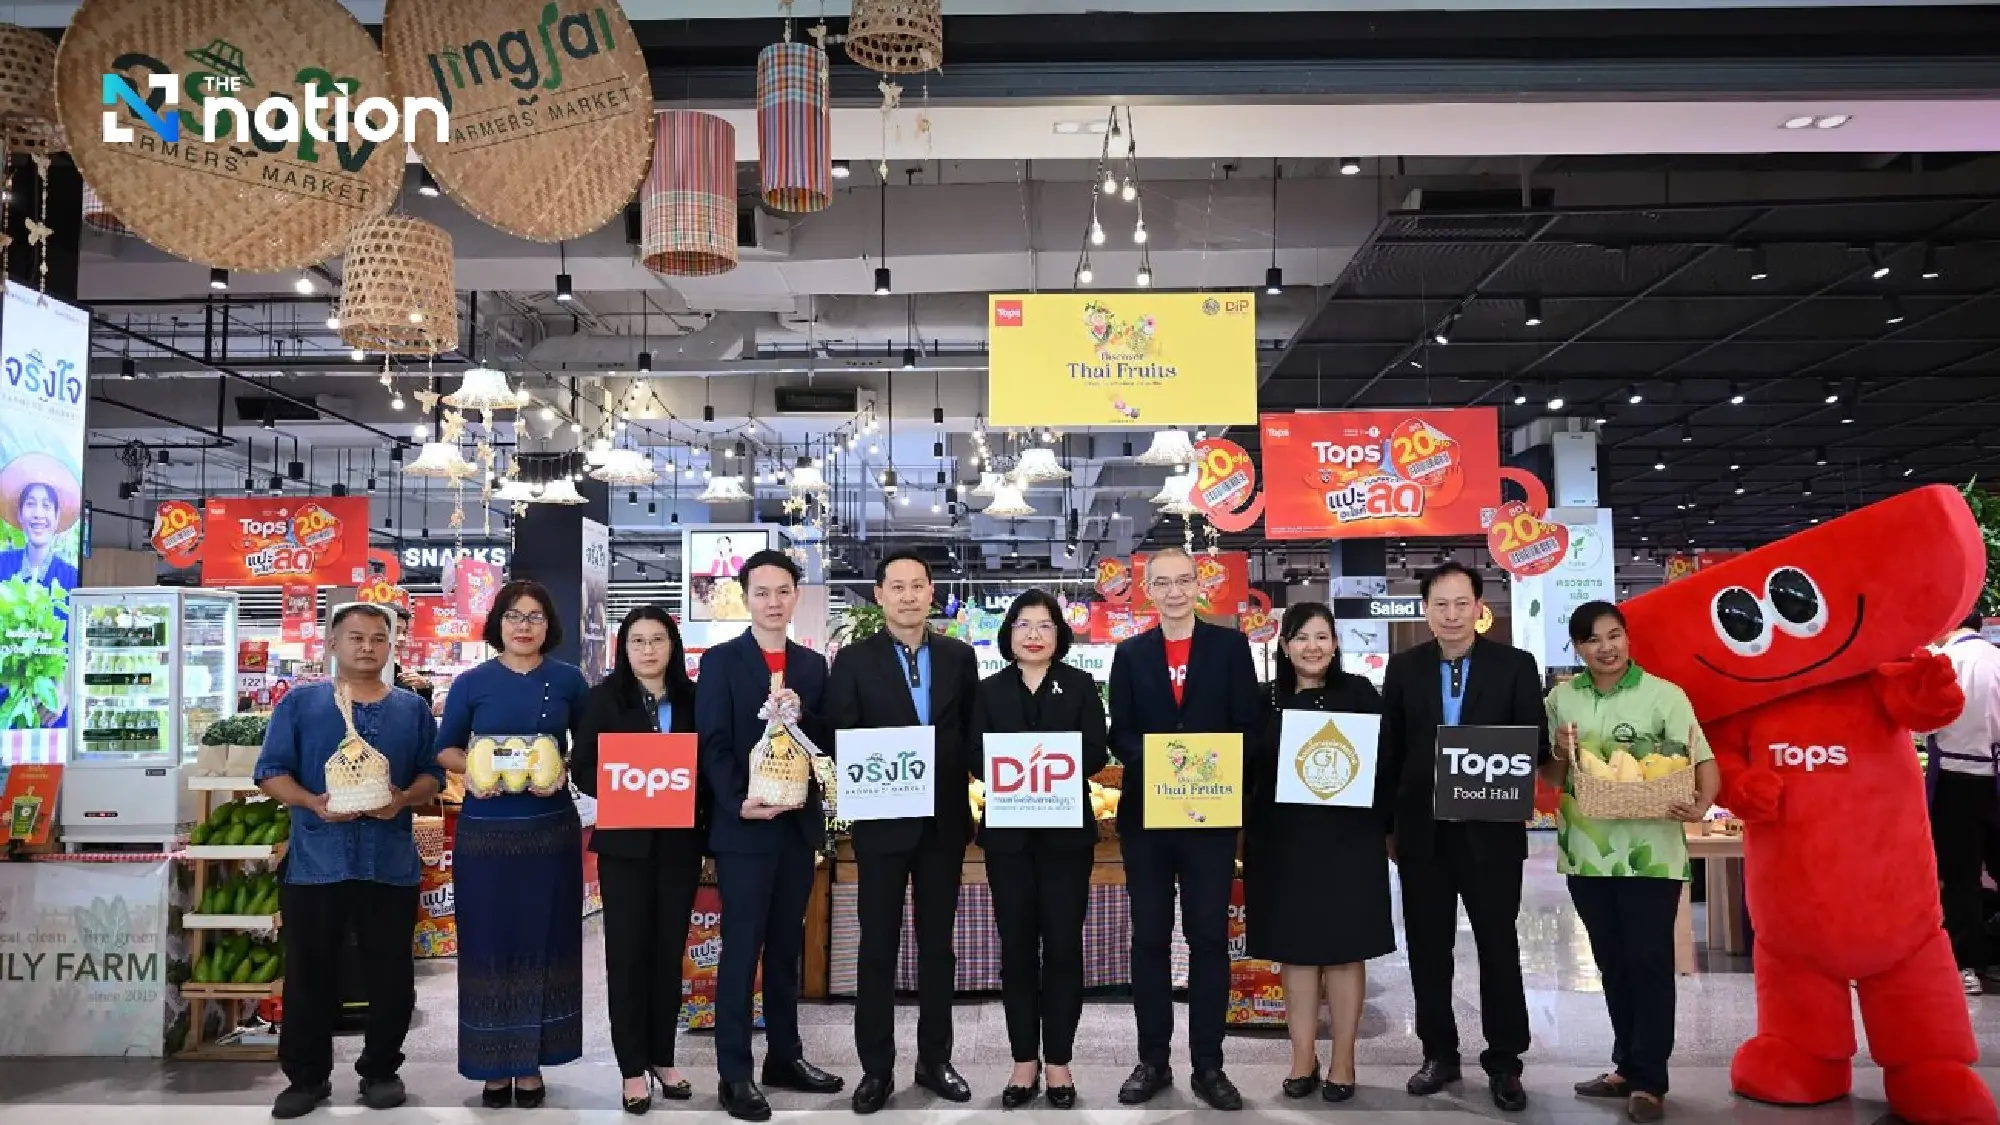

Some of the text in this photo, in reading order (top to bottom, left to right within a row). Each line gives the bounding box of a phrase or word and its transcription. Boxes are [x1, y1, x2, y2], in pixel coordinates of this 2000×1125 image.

[447, 86, 631, 146] ARMERS' MARKET
[261, 164, 371, 204] MARKET
[1066, 361, 1177, 378] Thai Fruits
[1311, 441, 1381, 469] Tops
[1367, 481, 1422, 514] ลด
[239, 518, 287, 538] Tops
[274, 548, 313, 571] ลด
[1370, 600, 1415, 616] Salad
[847, 750, 926, 784] จริงใจ
[1443, 747, 1531, 783] Tops
[1768, 743, 1849, 772] Tops
[603, 763, 691, 798] Tops
[1154, 783, 1233, 795] Thai Fruits
[1453, 786, 1519, 800] Food Hall
[27, 929, 67, 943] clean
[56, 952, 158, 981] FARM
